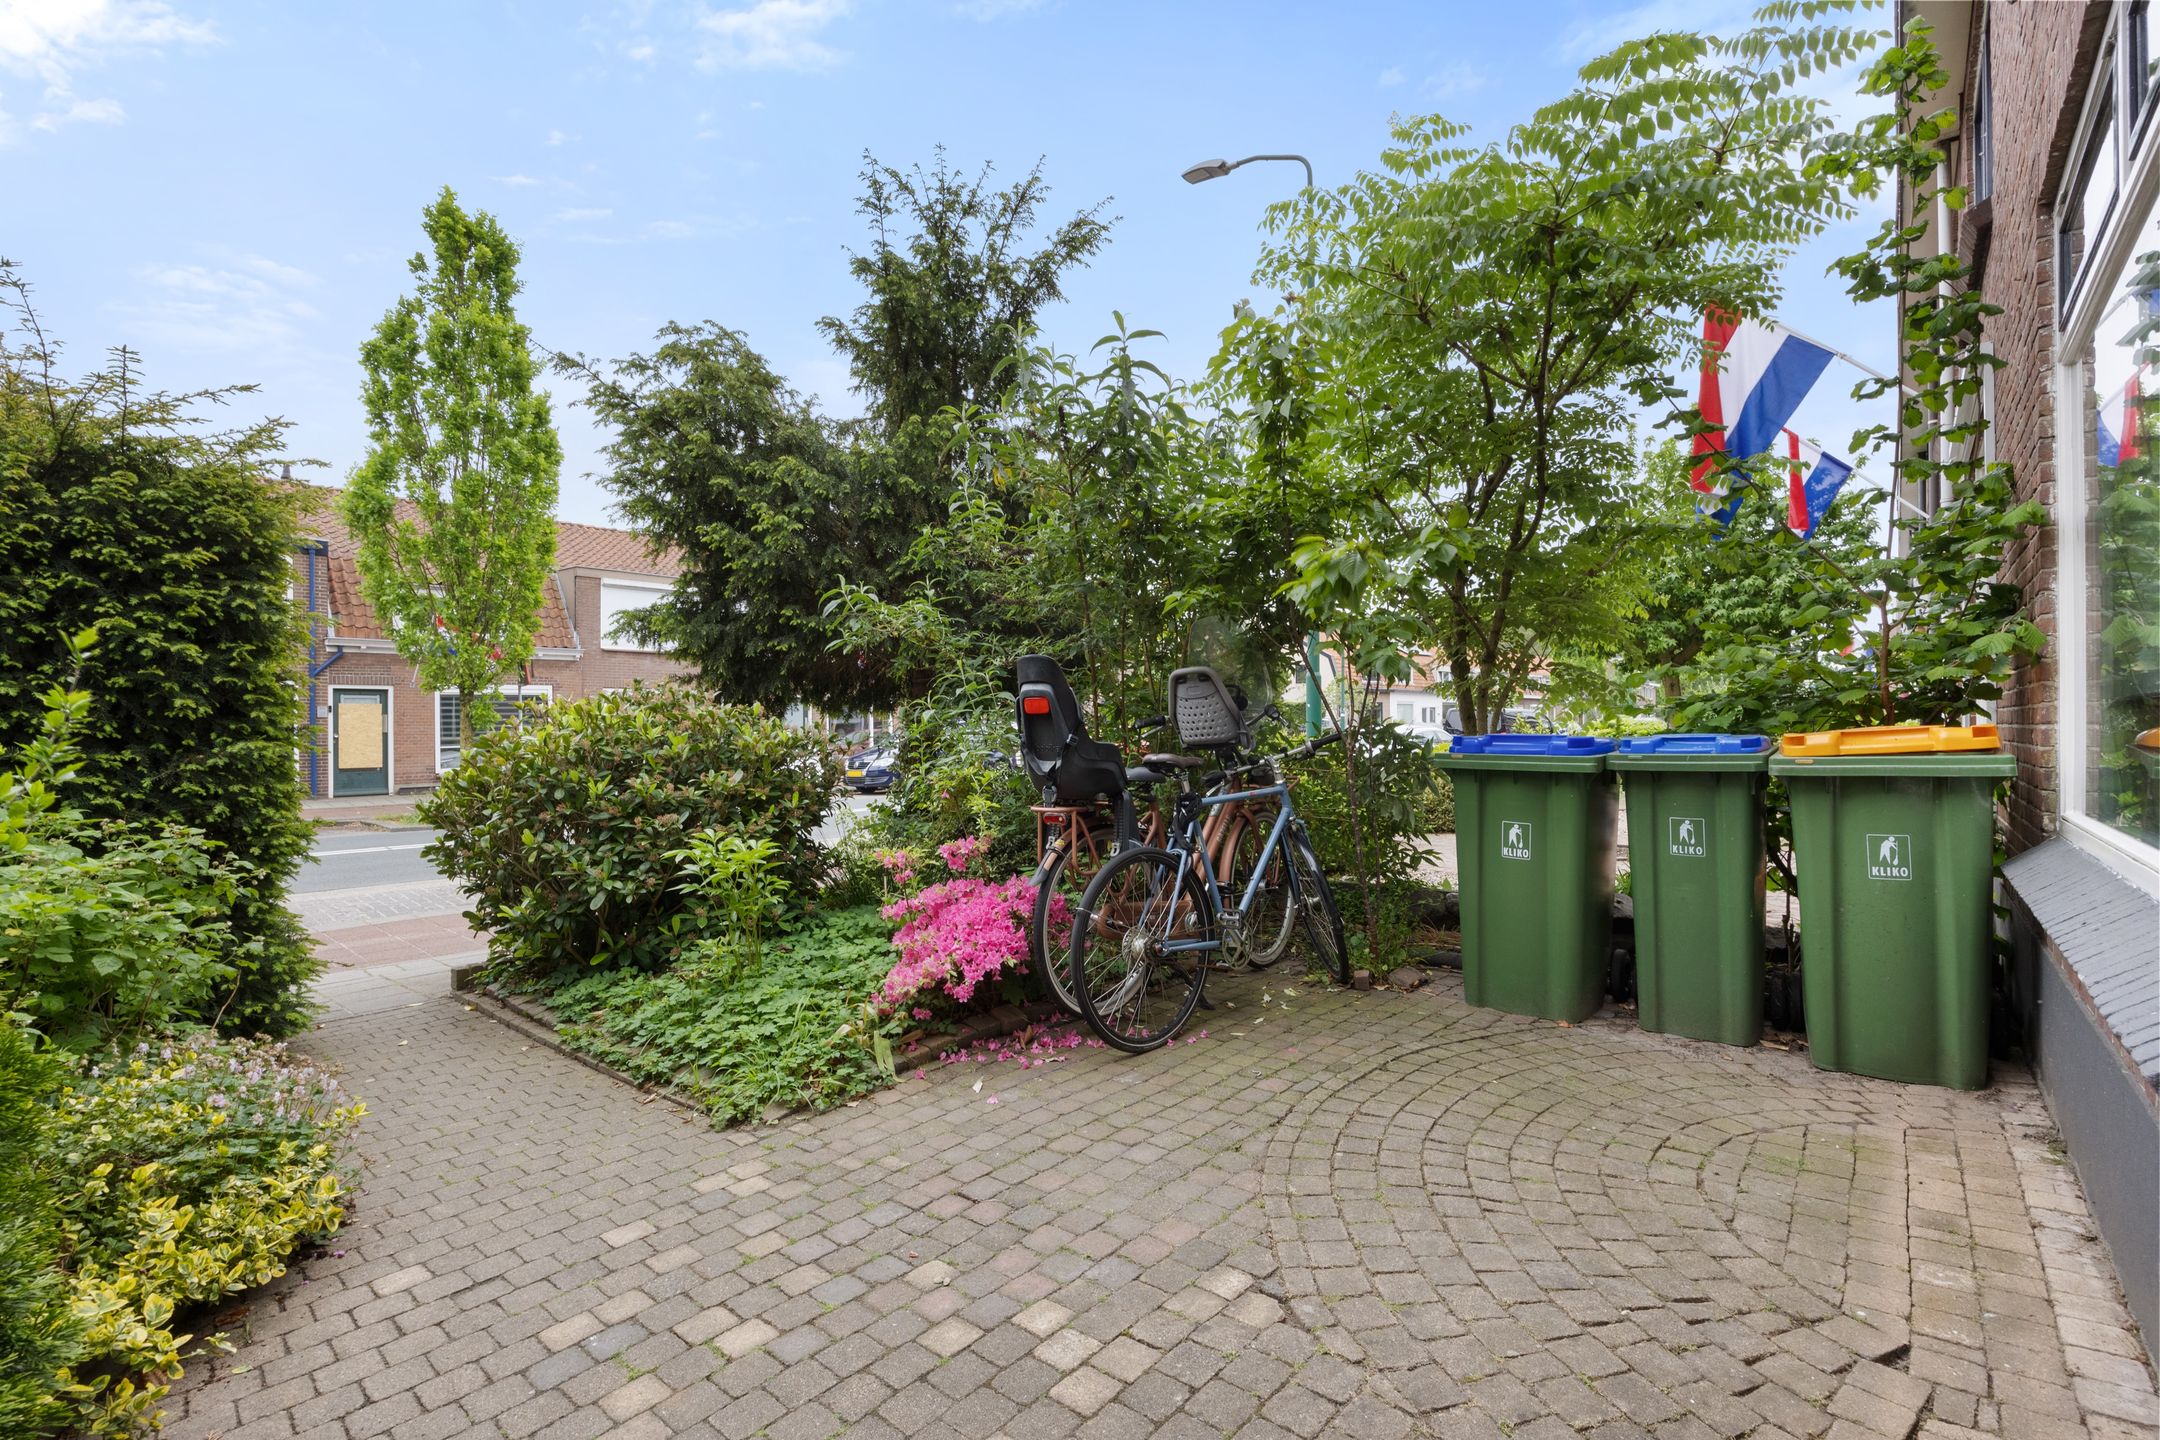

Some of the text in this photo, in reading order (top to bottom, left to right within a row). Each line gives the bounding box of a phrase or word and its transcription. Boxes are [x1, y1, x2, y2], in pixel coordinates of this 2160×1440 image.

[1503, 847, 1529, 858] KLIKO
[1673, 844, 1703, 855] KLIKO
[1872, 866, 1908, 877] KLIKO
